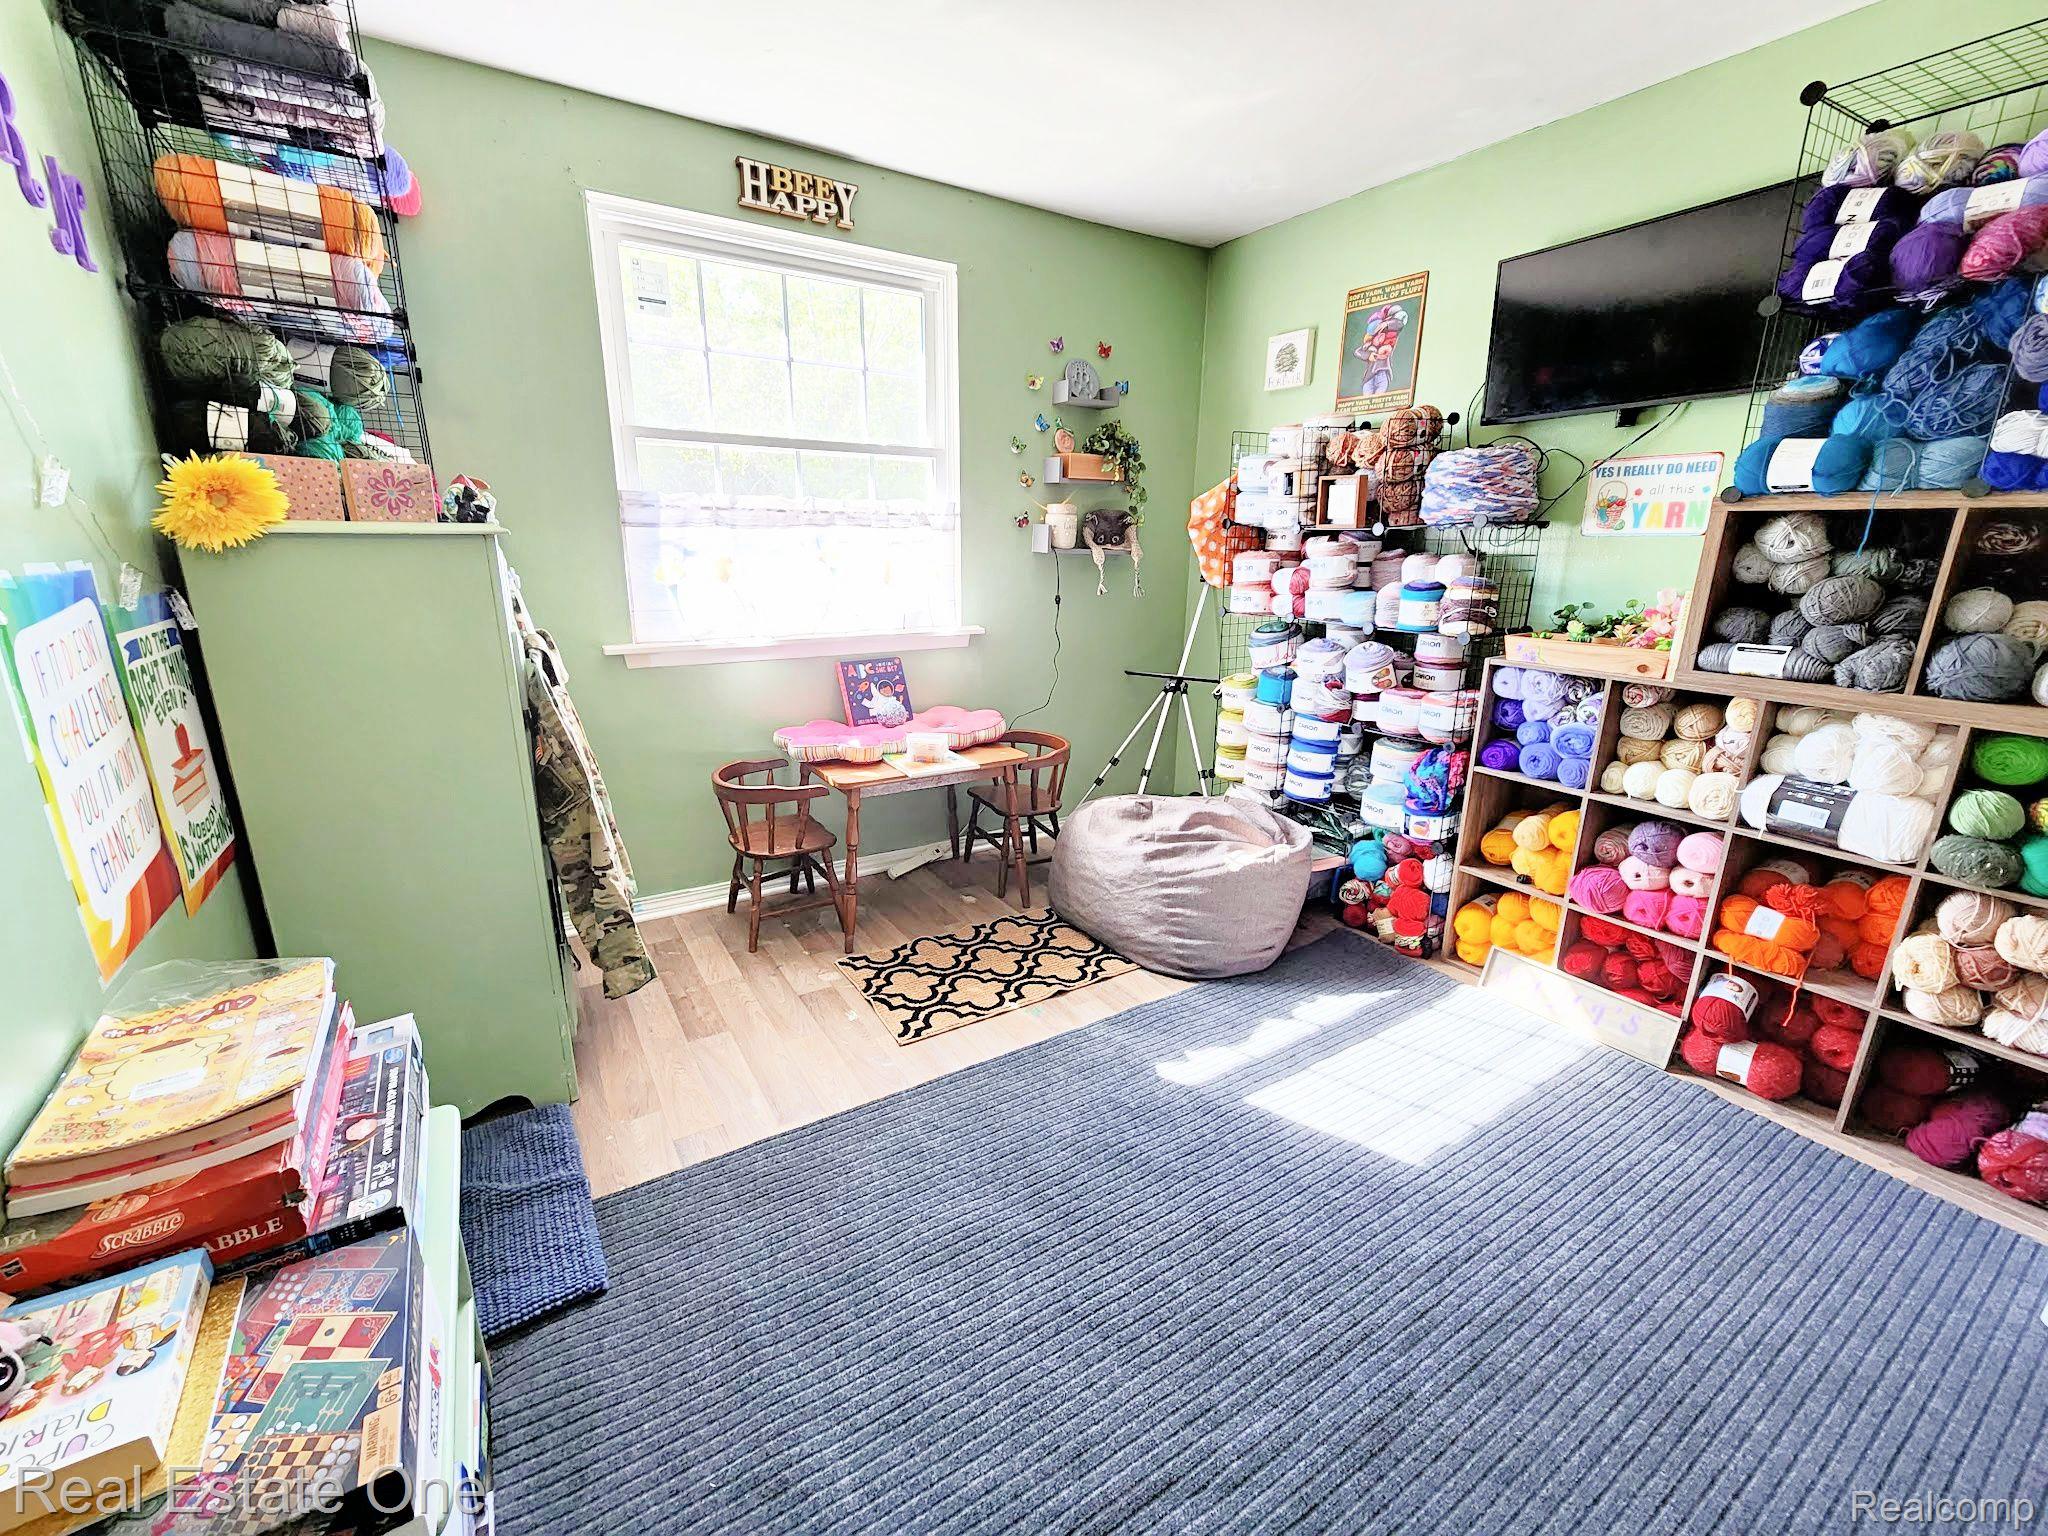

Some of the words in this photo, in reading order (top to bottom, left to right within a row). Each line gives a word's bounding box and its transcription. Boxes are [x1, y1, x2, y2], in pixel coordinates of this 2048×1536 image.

[735, 155, 858, 230] HAPPY
[771, 164, 835, 203] BEE
[1348, 298, 1370, 308] LITTLE
[1371, 293, 1388, 303] BALL
[1390, 290, 1399, 299] OF
[1401, 284, 1423, 296] FLUFF
[1349, 292, 1365, 302] SOFT
[1384, 282, 1405, 293] WARM
[1406, 277, 1424, 287] YARN
[1596, 466, 1614, 478] YES
[1617, 466, 1622, 477] I
[1623, 464, 1665, 477] REALLY
[1666, 462, 1683, 475] DO
[1686, 460, 1718, 473] NEED
[1650, 484, 1665, 496] all
[1670, 484, 1696, 495] this
[1631, 501, 1707, 529] YARN
[139, 634, 152, 659] DO
[151, 628, 170, 653] THE
[30, 650, 49, 699] IF
[46, 642, 64, 691] IT
[846, 662, 875, 679] ABC
[1414, 671, 1436, 681] CARON
[128, 659, 164, 727] RIGHT
[154, 687, 178, 726] EVEN
[178, 689, 187, 710] IF
[49, 672, 123, 768] CHALLENGE
[97, 763, 114, 809] IT
[174, 830, 195, 883] IS
[190, 789, 234, 872] WATCHING
[188, 798, 217, 839] NOBODY
[90, 806, 142, 895] CHANGE
[134, 791, 155, 841] YOU
[99, 1214, 182, 1254] SCRABBLE
